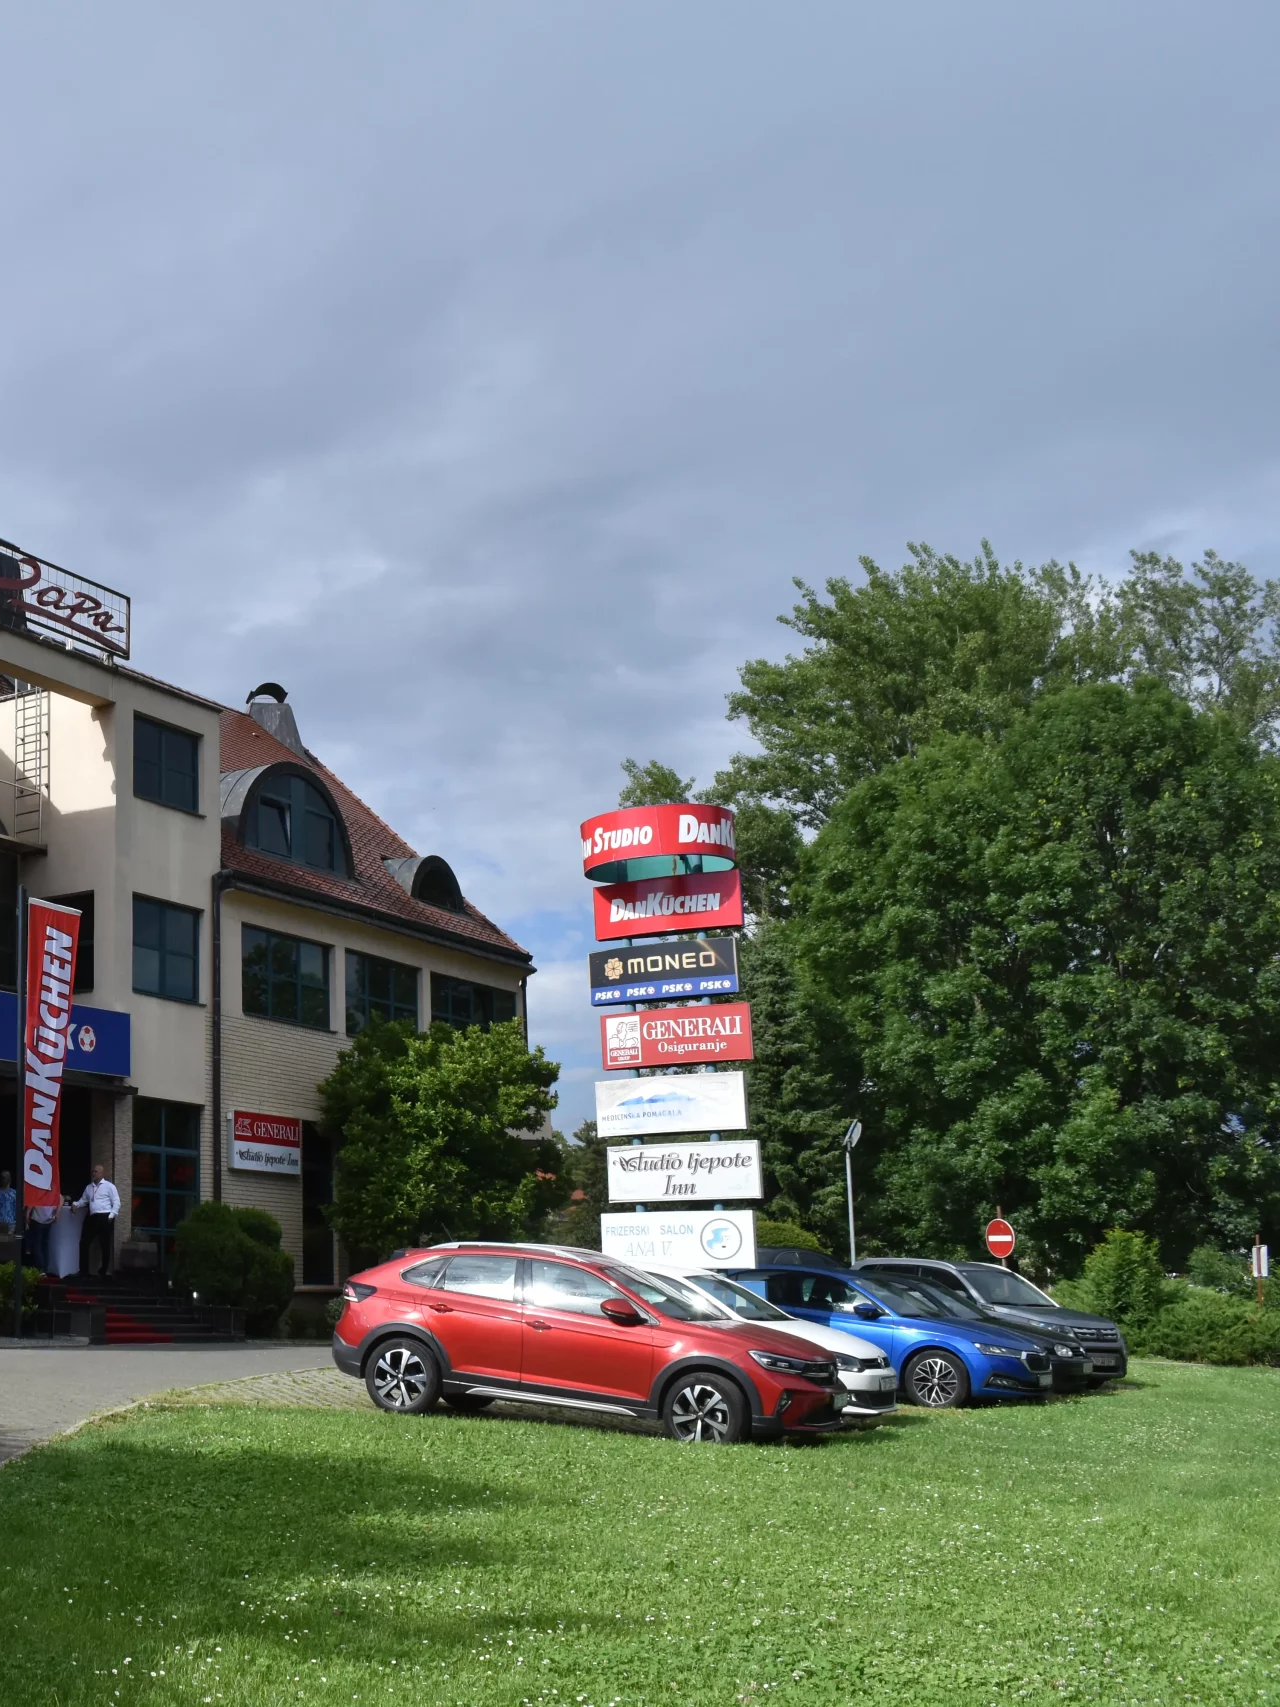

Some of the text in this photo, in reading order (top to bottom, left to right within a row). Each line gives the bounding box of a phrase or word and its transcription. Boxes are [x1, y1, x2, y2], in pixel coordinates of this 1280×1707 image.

[594, 826, 653, 854] STUDIO
[627, 951, 716, 975] MONEO
[642, 1016, 743, 1040] GENERALI
[657, 1040, 727, 1055] Osiguranje
[253, 1121, 299, 1141] GENERALI
[687, 1152, 753, 1175] ljepote
[662, 1174, 697, 1196] Inn
[605, 1224, 694, 1236] FRIZERSKI SALON
[624, 1241, 656, 1257] ANA
